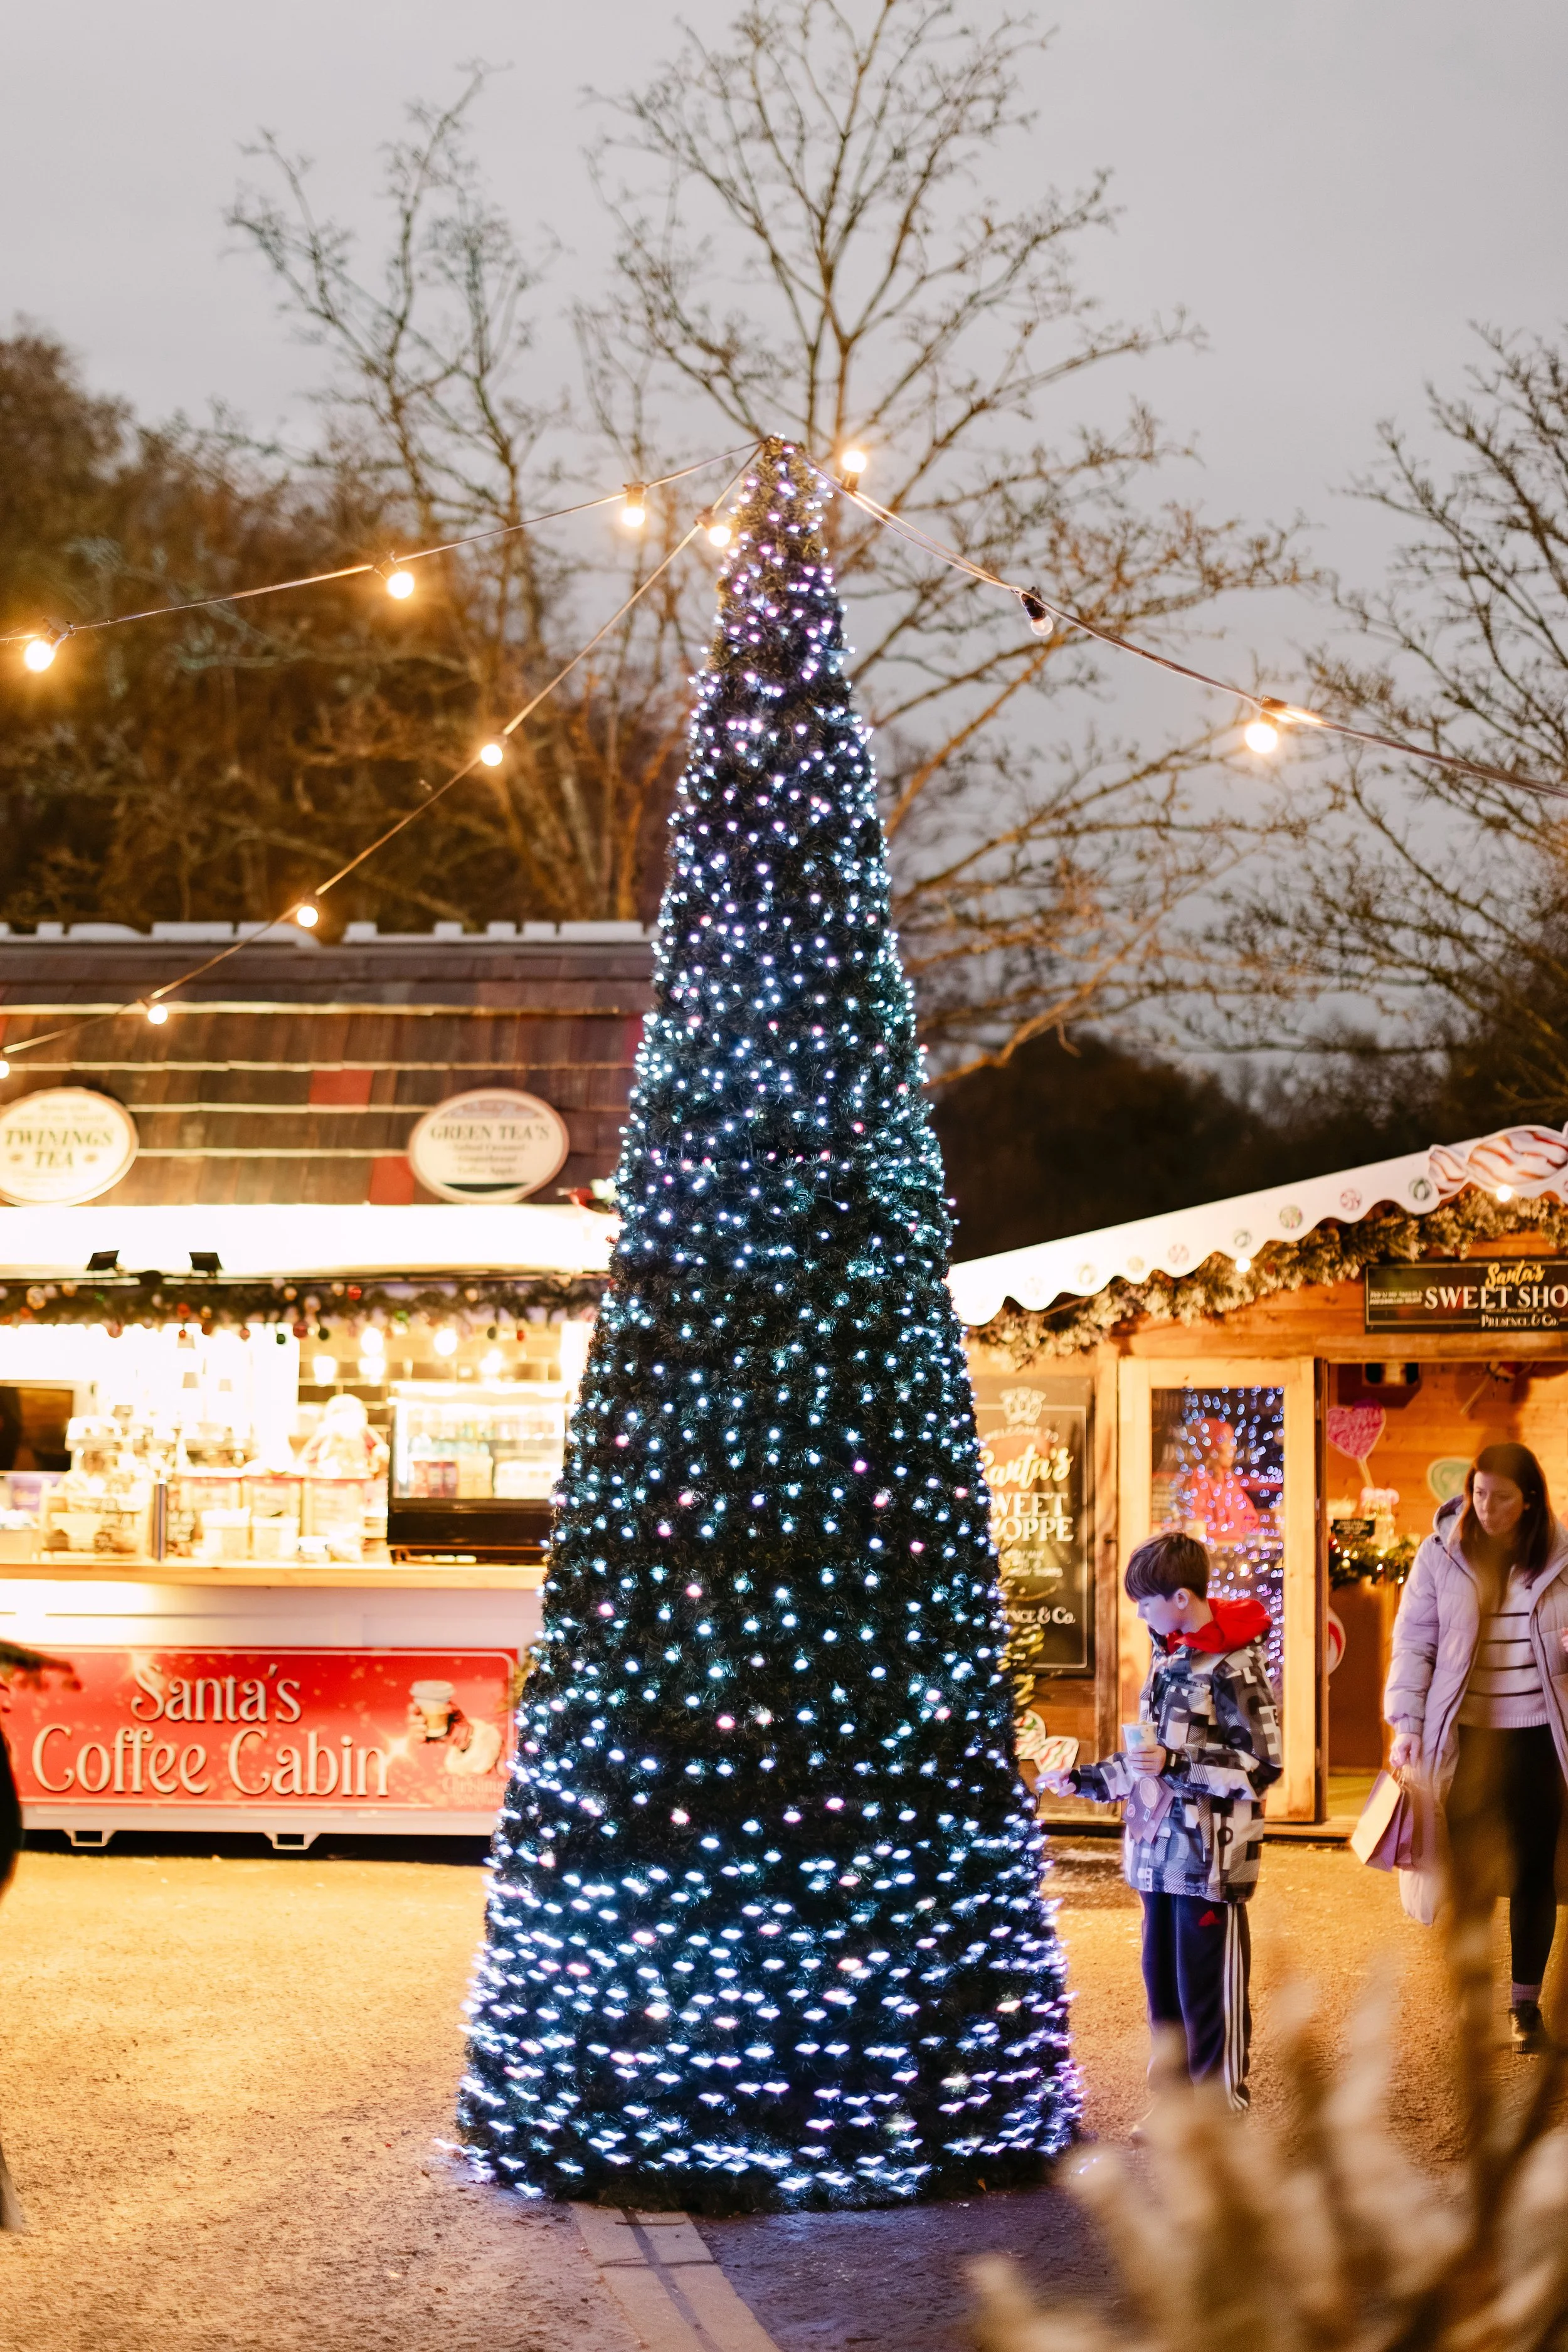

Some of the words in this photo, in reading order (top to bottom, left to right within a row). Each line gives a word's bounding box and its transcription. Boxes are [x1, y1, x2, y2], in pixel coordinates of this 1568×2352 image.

[6, 1128, 114, 1147] TWININGS
[431, 1125, 492, 1140] GREEN
[499, 1125, 549, 1140] TEA'S
[35, 1151, 74, 1168] TEA
[1485, 1259, 1545, 1291] Santa's
[1424, 1286, 1513, 1310] SWEET
[983, 1424, 1042, 1442] WELCOME
[1044, 1428, 1059, 1443] TO
[990, 1492, 1069, 1517] WEET
[992, 1517, 1074, 1541] OPPE
[131, 1663, 301, 1723] Santa's
[32, 1724, 209, 1794] Coffee
[228, 1729, 389, 1797] Cabin
